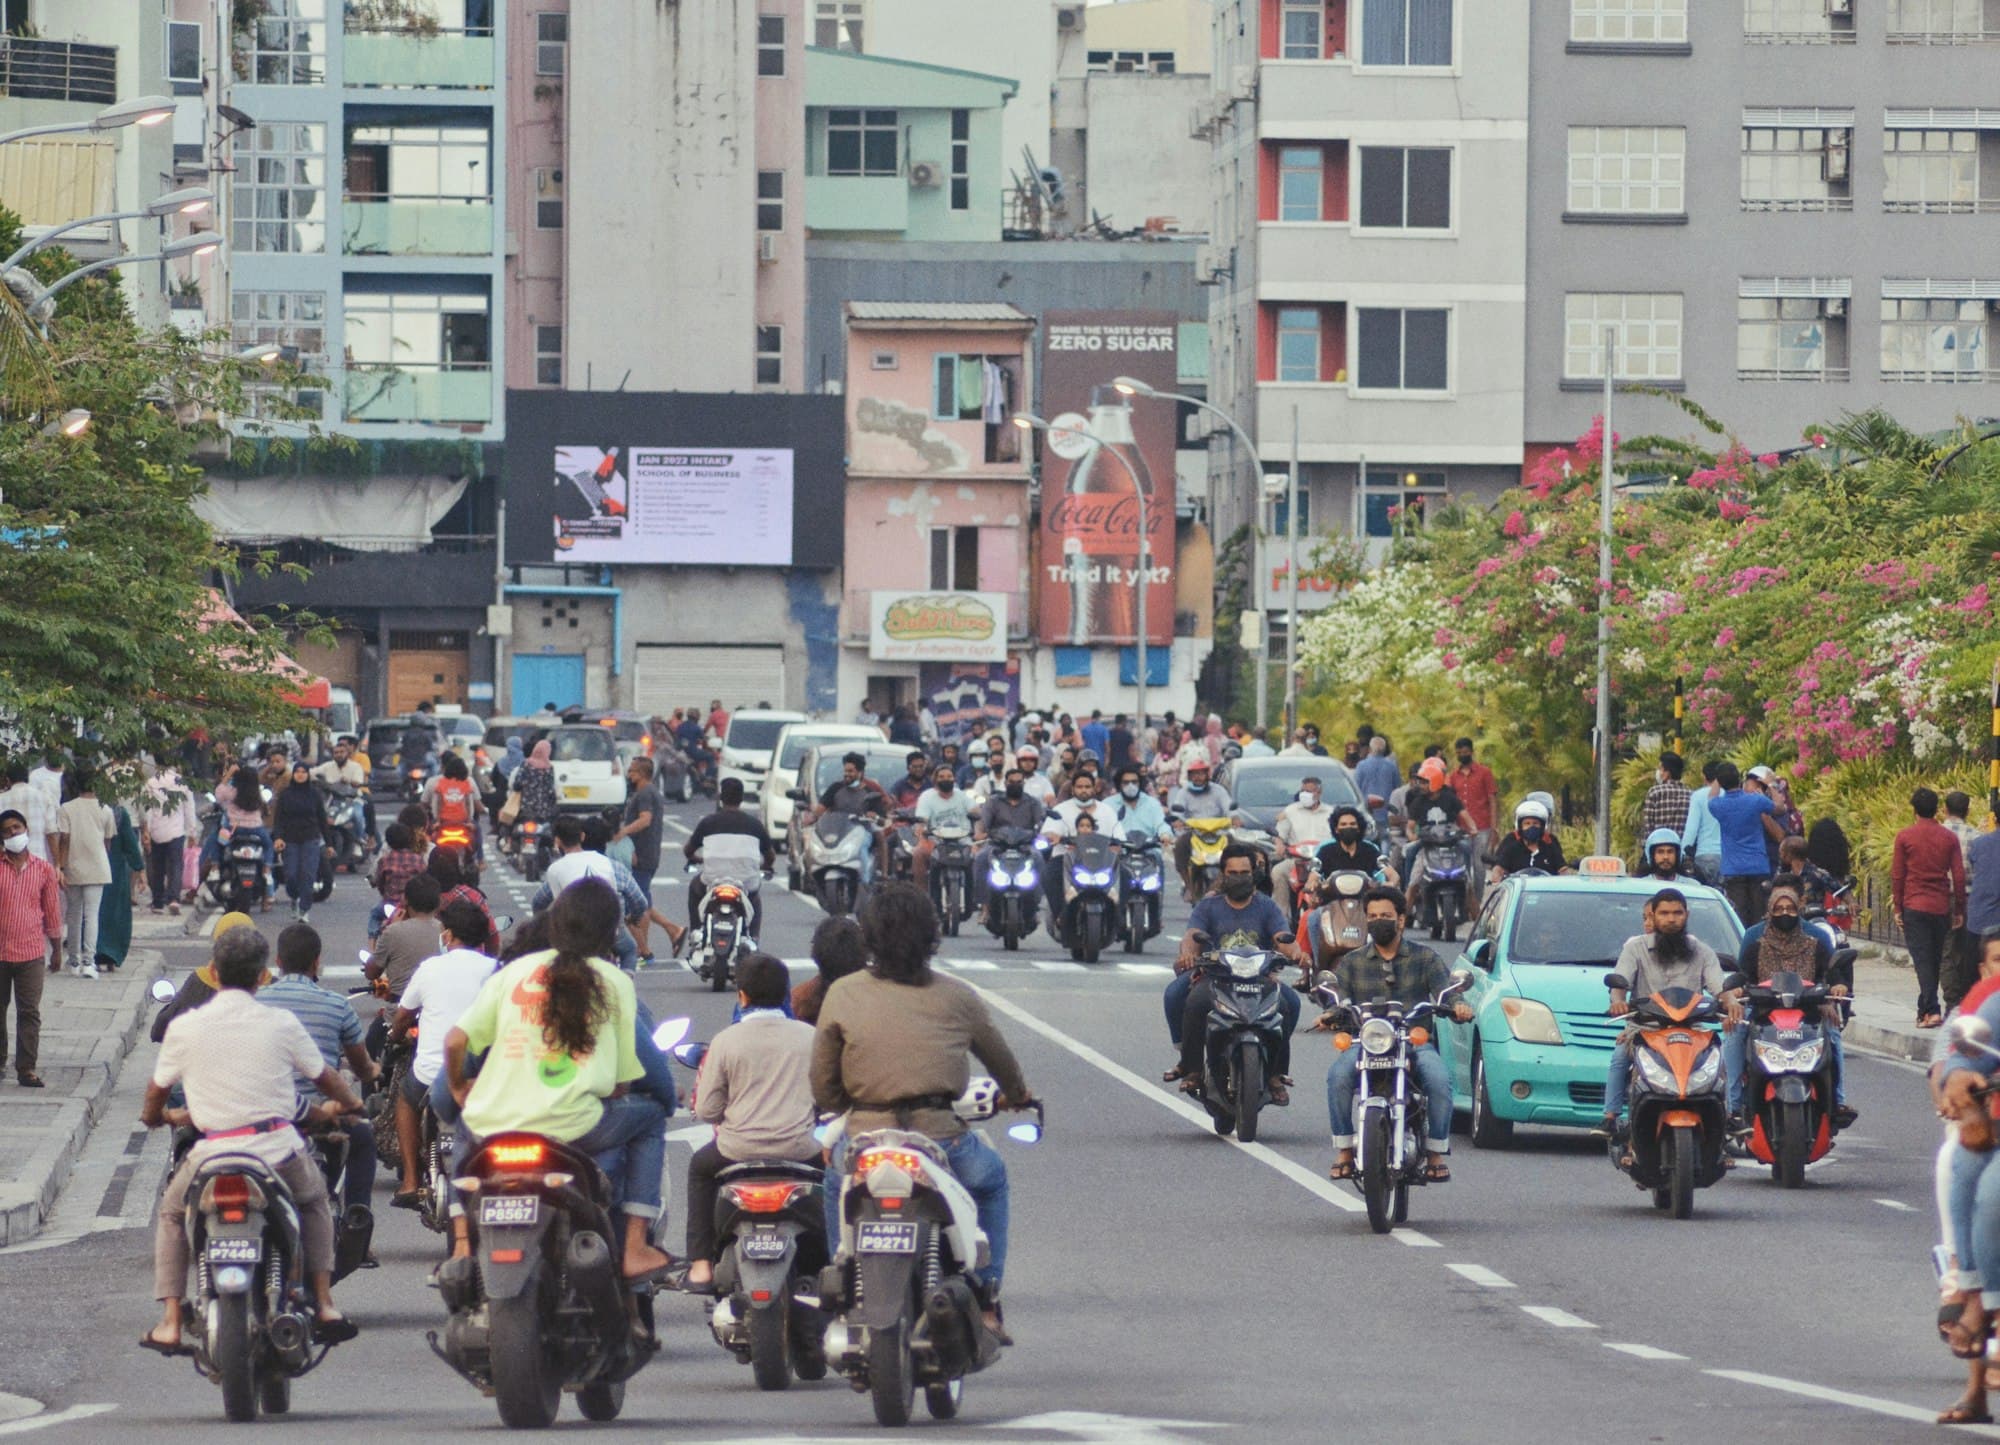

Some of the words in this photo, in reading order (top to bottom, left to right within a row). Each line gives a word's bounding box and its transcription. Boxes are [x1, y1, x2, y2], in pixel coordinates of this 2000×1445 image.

[1083, 326, 1101, 335] THE
[1103, 326, 1131, 335] TASTE
[1132, 327, 1146, 335] OF
[1147, 327, 1173, 336] COKE
[1049, 335, 1102, 351] ZERO
[1106, 336, 1174, 352] SUGAR
[639, 454, 661, 465] JAN
[691, 455, 730, 467] INTAKE
[637, 470, 676, 478] SCHOOL
[679, 470, 692, 478] OF
[695, 471, 741, 479] BUSINESS
[1105, 564, 1121, 583] it
[1588, 860, 1619, 873] TAXI
[861, 1236, 910, 1249] P9271
